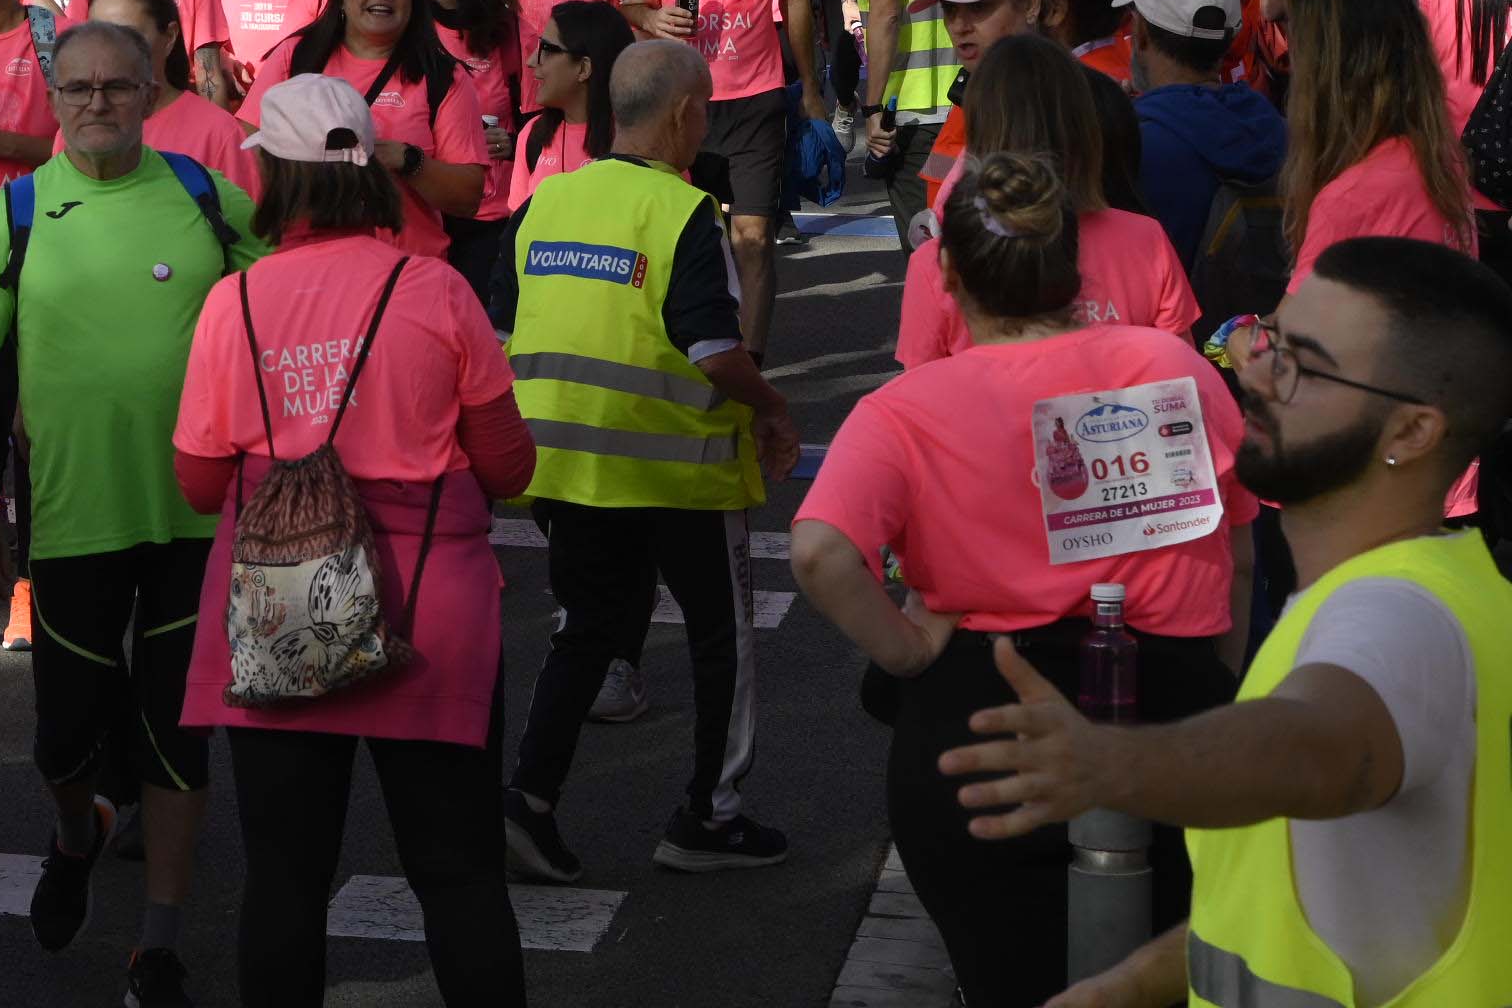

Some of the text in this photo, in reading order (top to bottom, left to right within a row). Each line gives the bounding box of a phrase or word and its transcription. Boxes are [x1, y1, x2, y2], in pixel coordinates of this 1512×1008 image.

[530, 250, 631, 275] VOLUNTARIS
[260, 335, 372, 372] CARRERA
[284, 362, 349, 394] DE LA
[1153, 400, 1187, 414] SUMA
[1081, 417, 1144, 436] ASTURIANA
[1090, 452, 1150, 481] 016
[1101, 482, 1148, 502] 27213
[1064, 494, 1201, 525] CARRERA DE LA MUJER 2023
[1157, 516, 1211, 535] Santander
[1062, 532, 1114, 551] OYSHO
